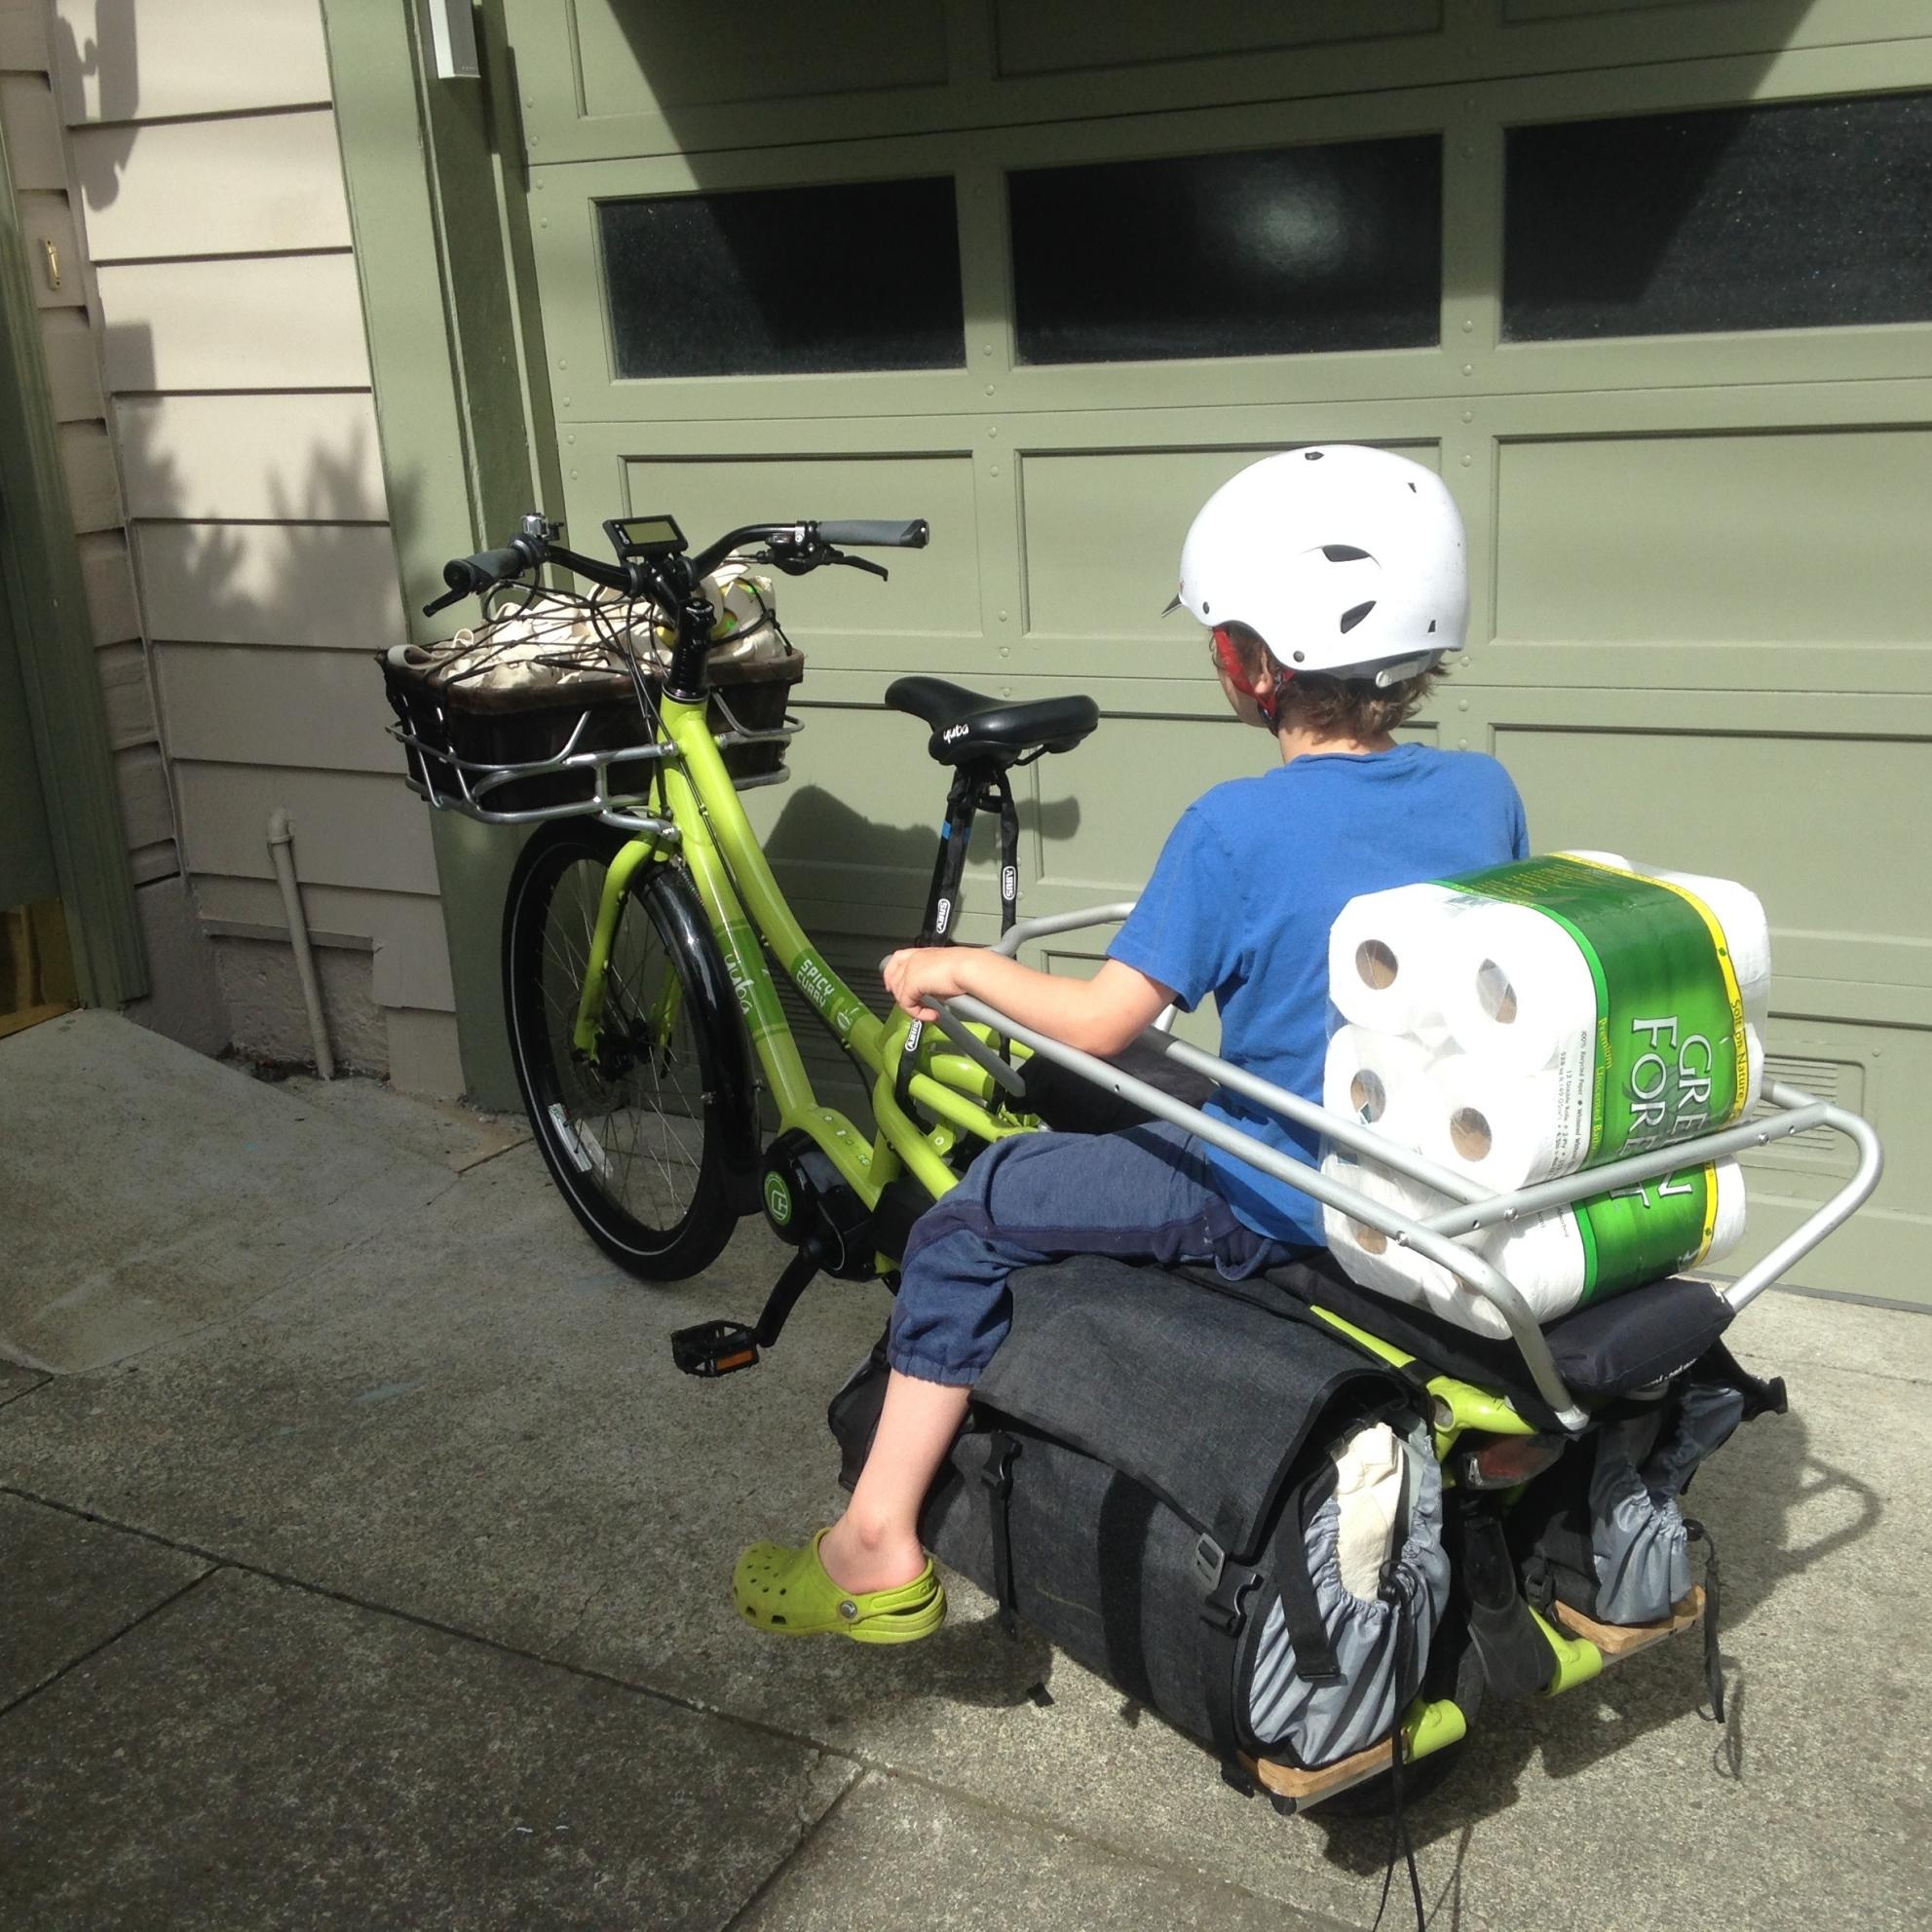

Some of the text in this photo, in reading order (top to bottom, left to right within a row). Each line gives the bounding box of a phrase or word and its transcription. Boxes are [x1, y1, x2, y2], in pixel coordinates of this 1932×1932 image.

[943, 723, 969, 744] yuba
[796, 970, 827, 1007] CURRY
[800, 959, 835, 996] SPICY
[1730, 999, 1743, 1025] Soft
[1598, 1017, 1613, 1069] Premium
[1735, 1032, 1746, 1047] on
[1593, 1066, 1605, 1121] Unscented
[1609, 1015, 1678, 1208] FORET
[1658, 1034, 1712, 1197] GREN
